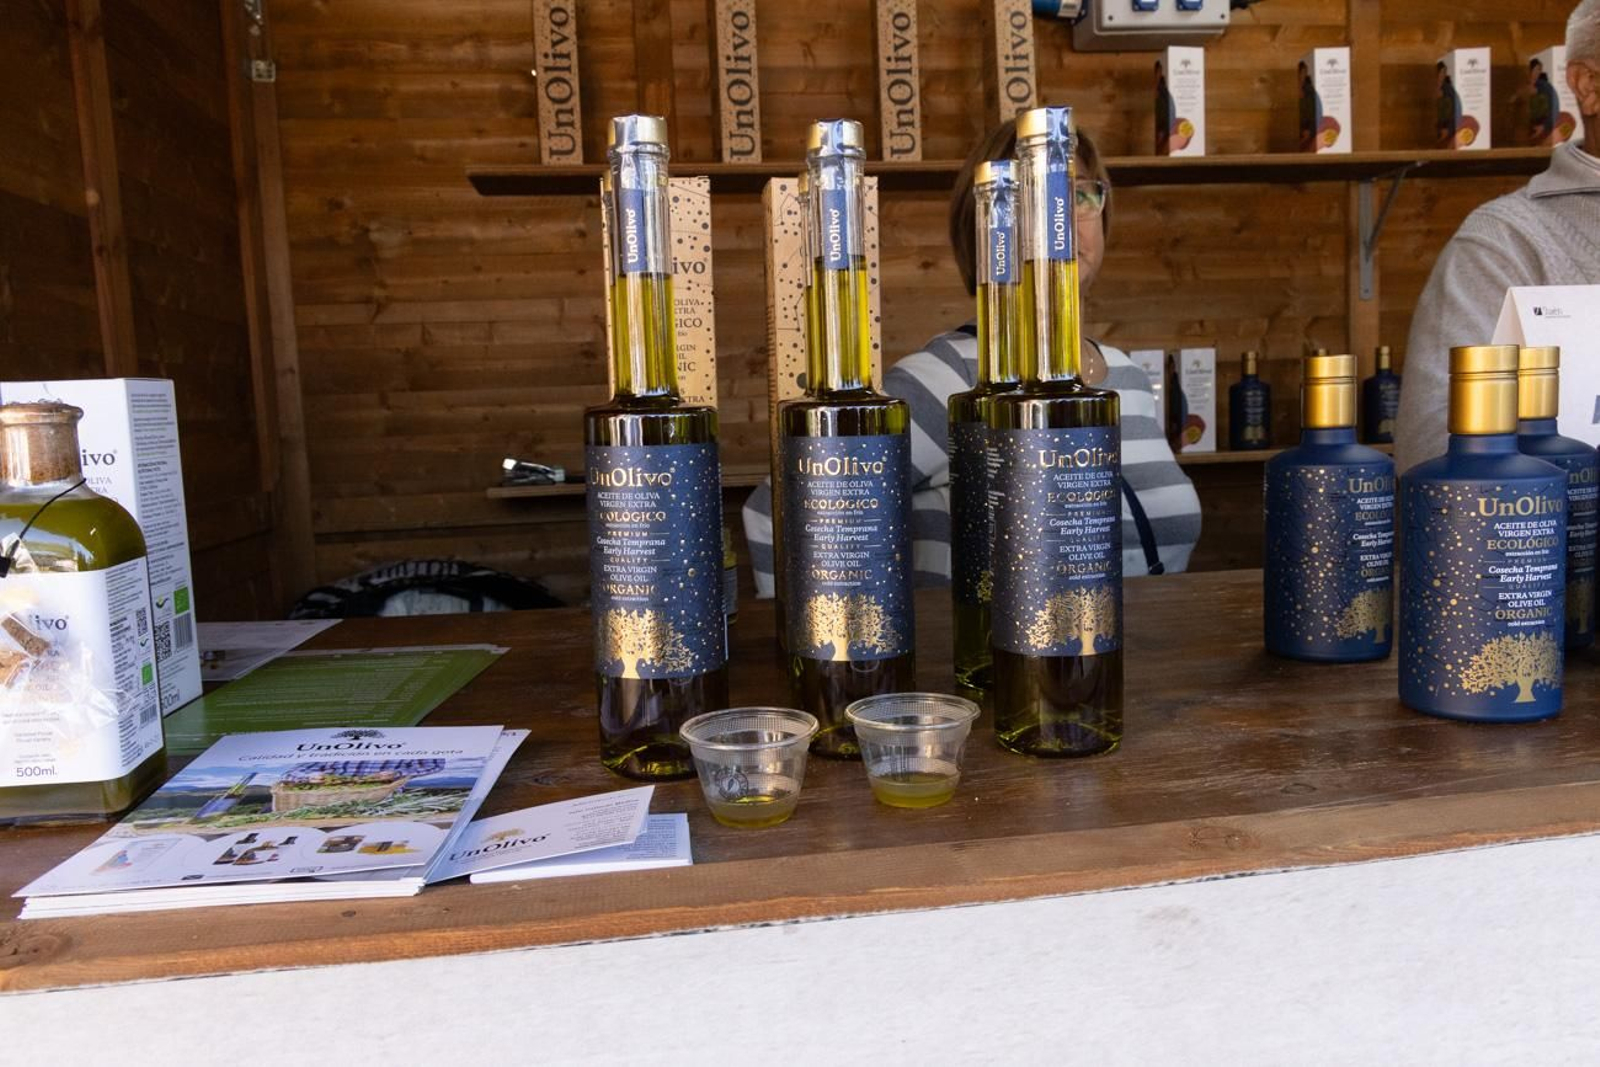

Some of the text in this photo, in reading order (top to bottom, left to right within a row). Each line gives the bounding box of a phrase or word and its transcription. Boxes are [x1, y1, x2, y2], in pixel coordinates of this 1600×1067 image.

[545, 6, 577, 158] UnOlivo
[727, 10, 756, 158] UnOlivo
[886, 11, 916, 157] UnOlivo
[1054, 198, 1065, 251] UnOlivo
[626, 210, 639, 264] UnOlivo
[830, 209, 841, 262] UnOlivo
[996, 233, 1006, 276] UnOlivo
[798, 456, 884, 476] UnOlivo
[590, 466, 673, 487] UnOlivo
[1053, 473, 1084, 481] ACEITE
[1084, 472, 1096, 480] DE
[806, 480, 874, 488] ACEITE DE OLIVA
[1057, 480, 1089, 489] VIRGEN
[622, 492, 633, 500] DE
[634, 491, 661, 500] OLIVA
[811, 489, 840, 497] VIRGEN
[600, 500, 657, 508] VIRGEN EXTRA
[1477, 495, 1563, 517] UnOlivo
[1049, 517, 1083, 527] Cosecha
[1493, 519, 1557, 530] ACEITE DE OLIVA
[835, 524, 878, 534] Temprana
[1060, 526, 1084, 536] Early
[1498, 527, 1555, 538] VIRGEN EXTRA
[623, 537, 666, 547] Temprana
[813, 533, 869, 543] Early Harvest
[1486, 536, 1559, 550] ECOLÓGICO
[603, 545, 656, 556] Early Harvest
[1060, 542, 1111, 553] EXTRA VIRGIN
[813, 550, 870, 559] EXTRA VIRGIN
[1068, 552, 1093, 561] OLIVE
[603, 564, 658, 573] EXTRA VIRGIN
[821, 560, 862, 568] OLIVE OIL
[811, 569, 874, 581] ORGANIC
[1488, 565, 1524, 575] Cosecha
[609, 573, 649, 582] OLIVE OIL
[1499, 574, 1524, 583] Early
[1498, 590, 1553, 600] EXTRA VIRGIN
[1507, 598, 1546, 608] OLIVE OIL
[1495, 606, 1554, 620] ORGANIC
[297, 742, 402, 752] UnOlivo
[238, 752, 295, 762] Calidad
[449, 835, 547, 861] UnOlivo
